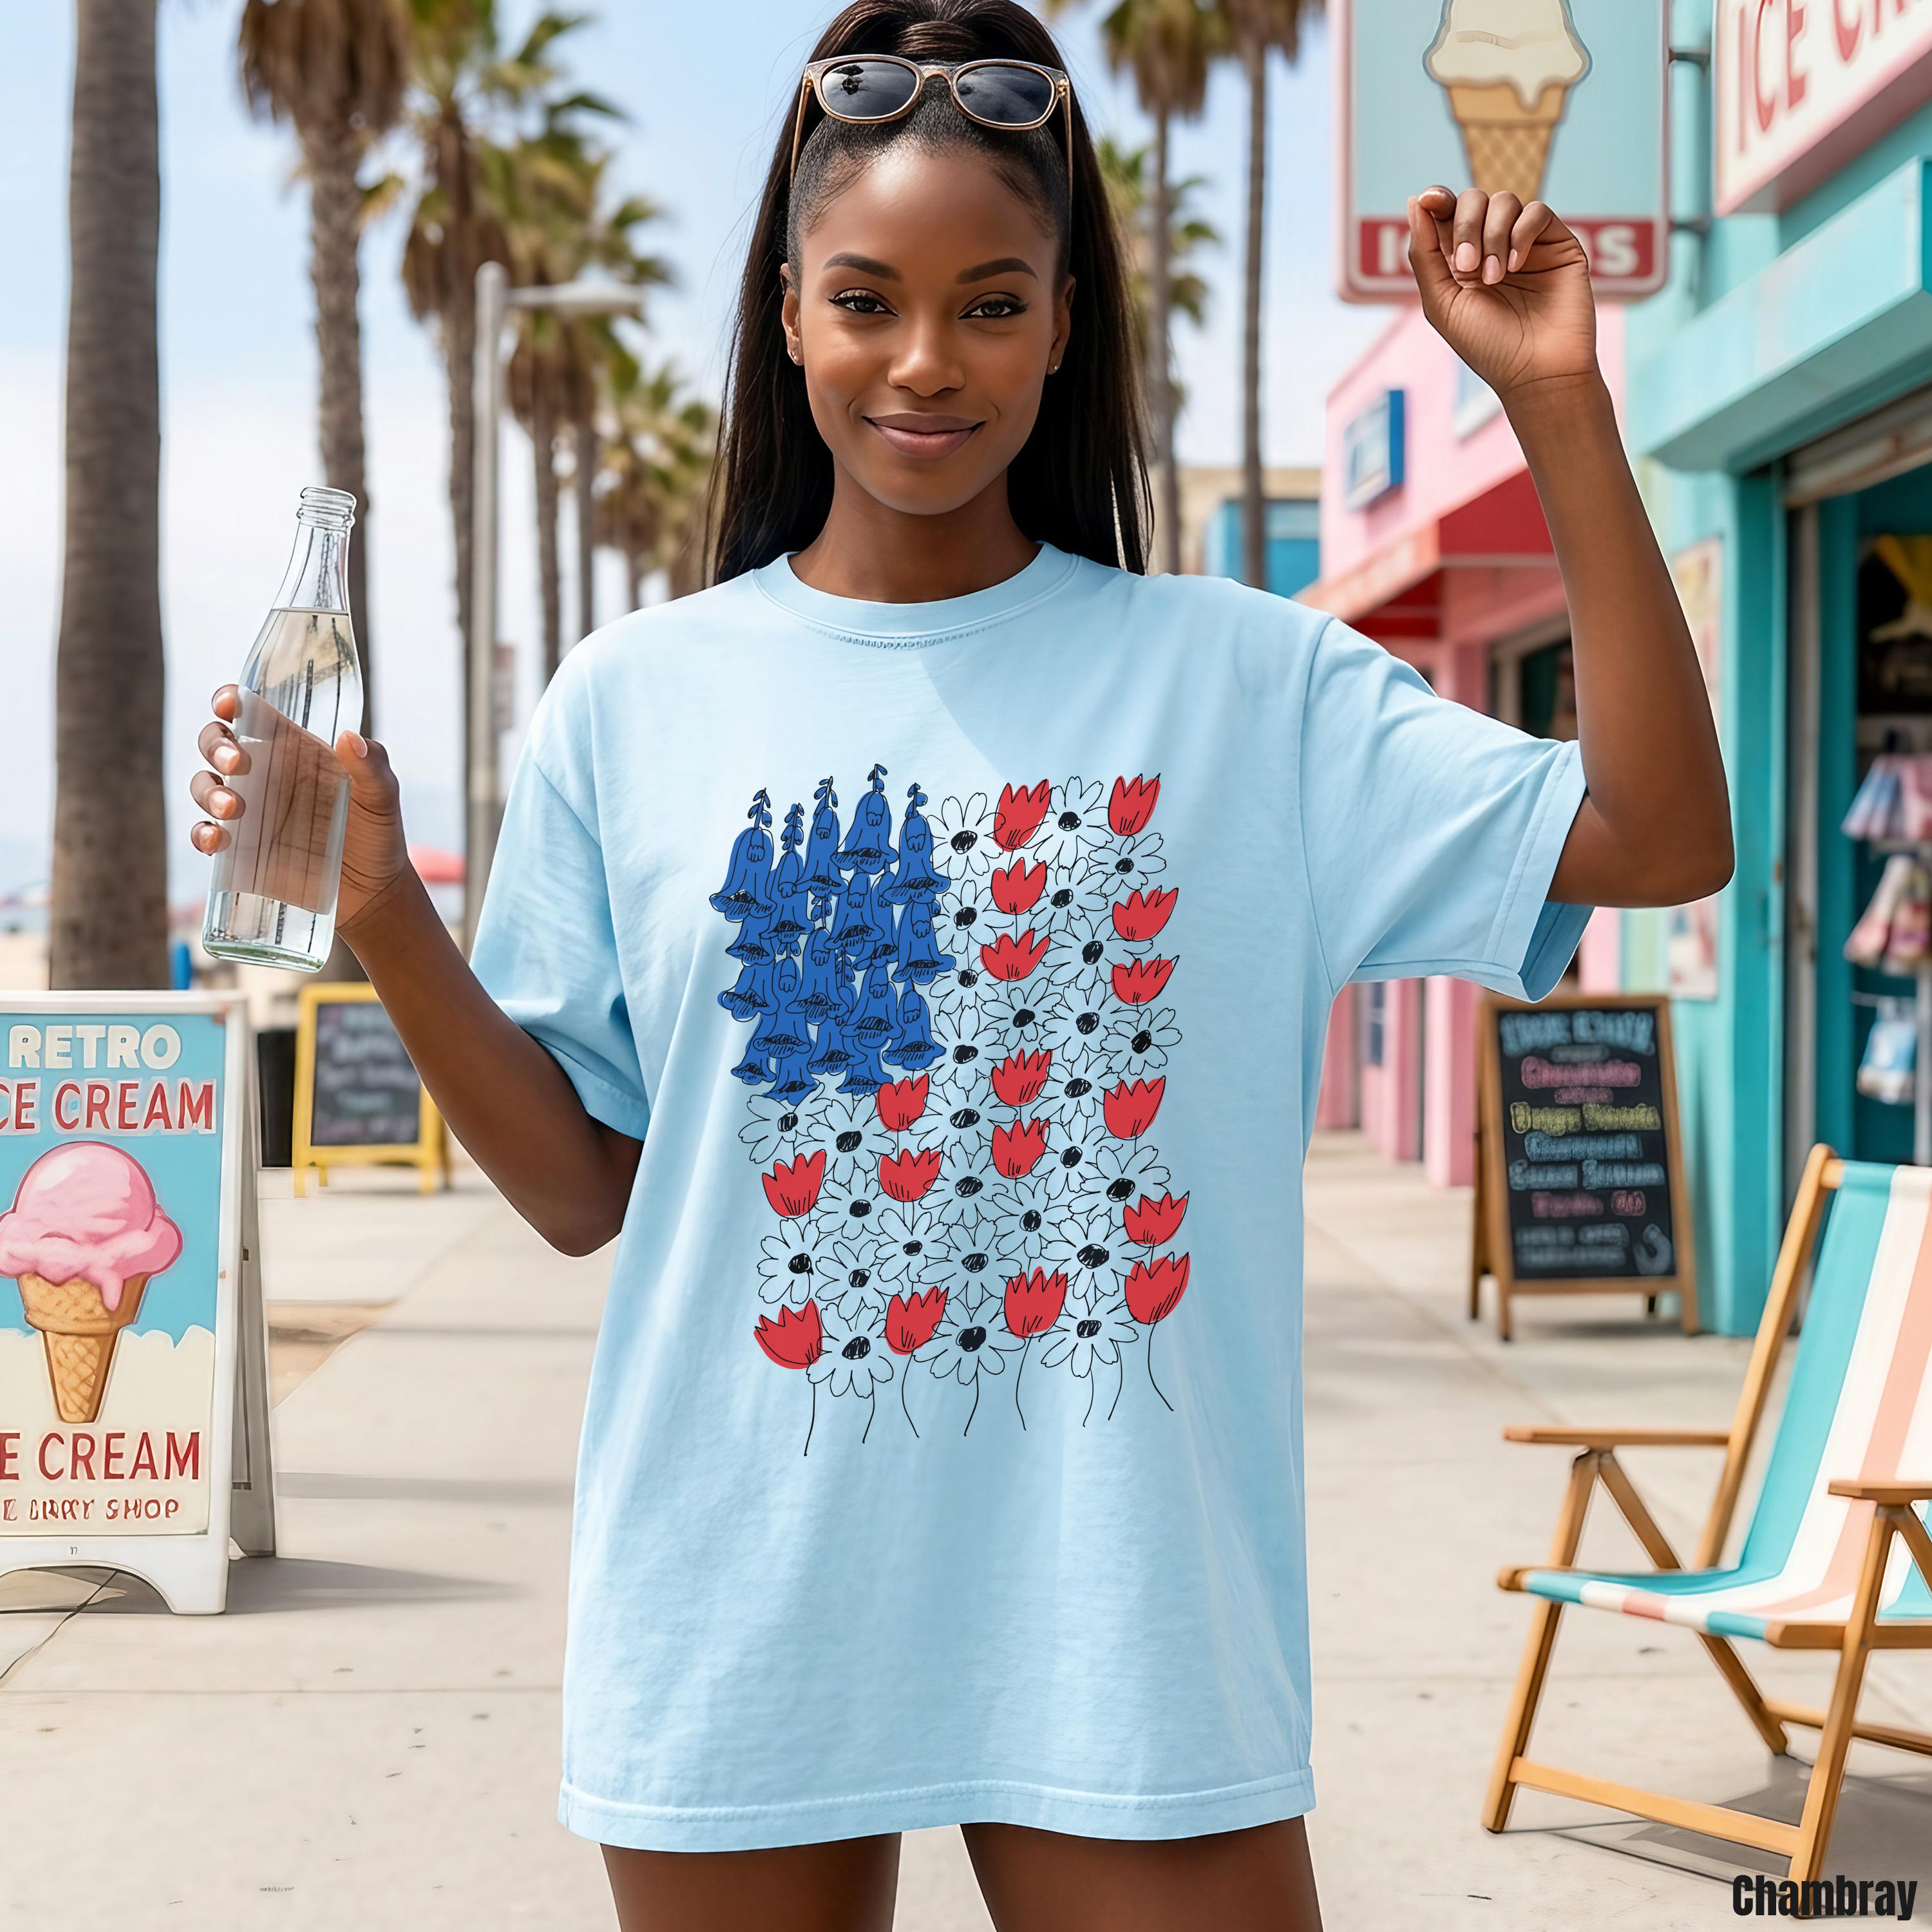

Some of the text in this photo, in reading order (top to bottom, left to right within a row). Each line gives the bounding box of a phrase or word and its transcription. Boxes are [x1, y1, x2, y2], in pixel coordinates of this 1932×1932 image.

[1739, 0, 1806, 152] ICE
[8, 1024, 182, 1070] RETRO
[55, 1082, 213, 1130] CREAM
[39, 1432, 200, 1480] CREAM
[106, 1498, 179, 1520] SHOP
